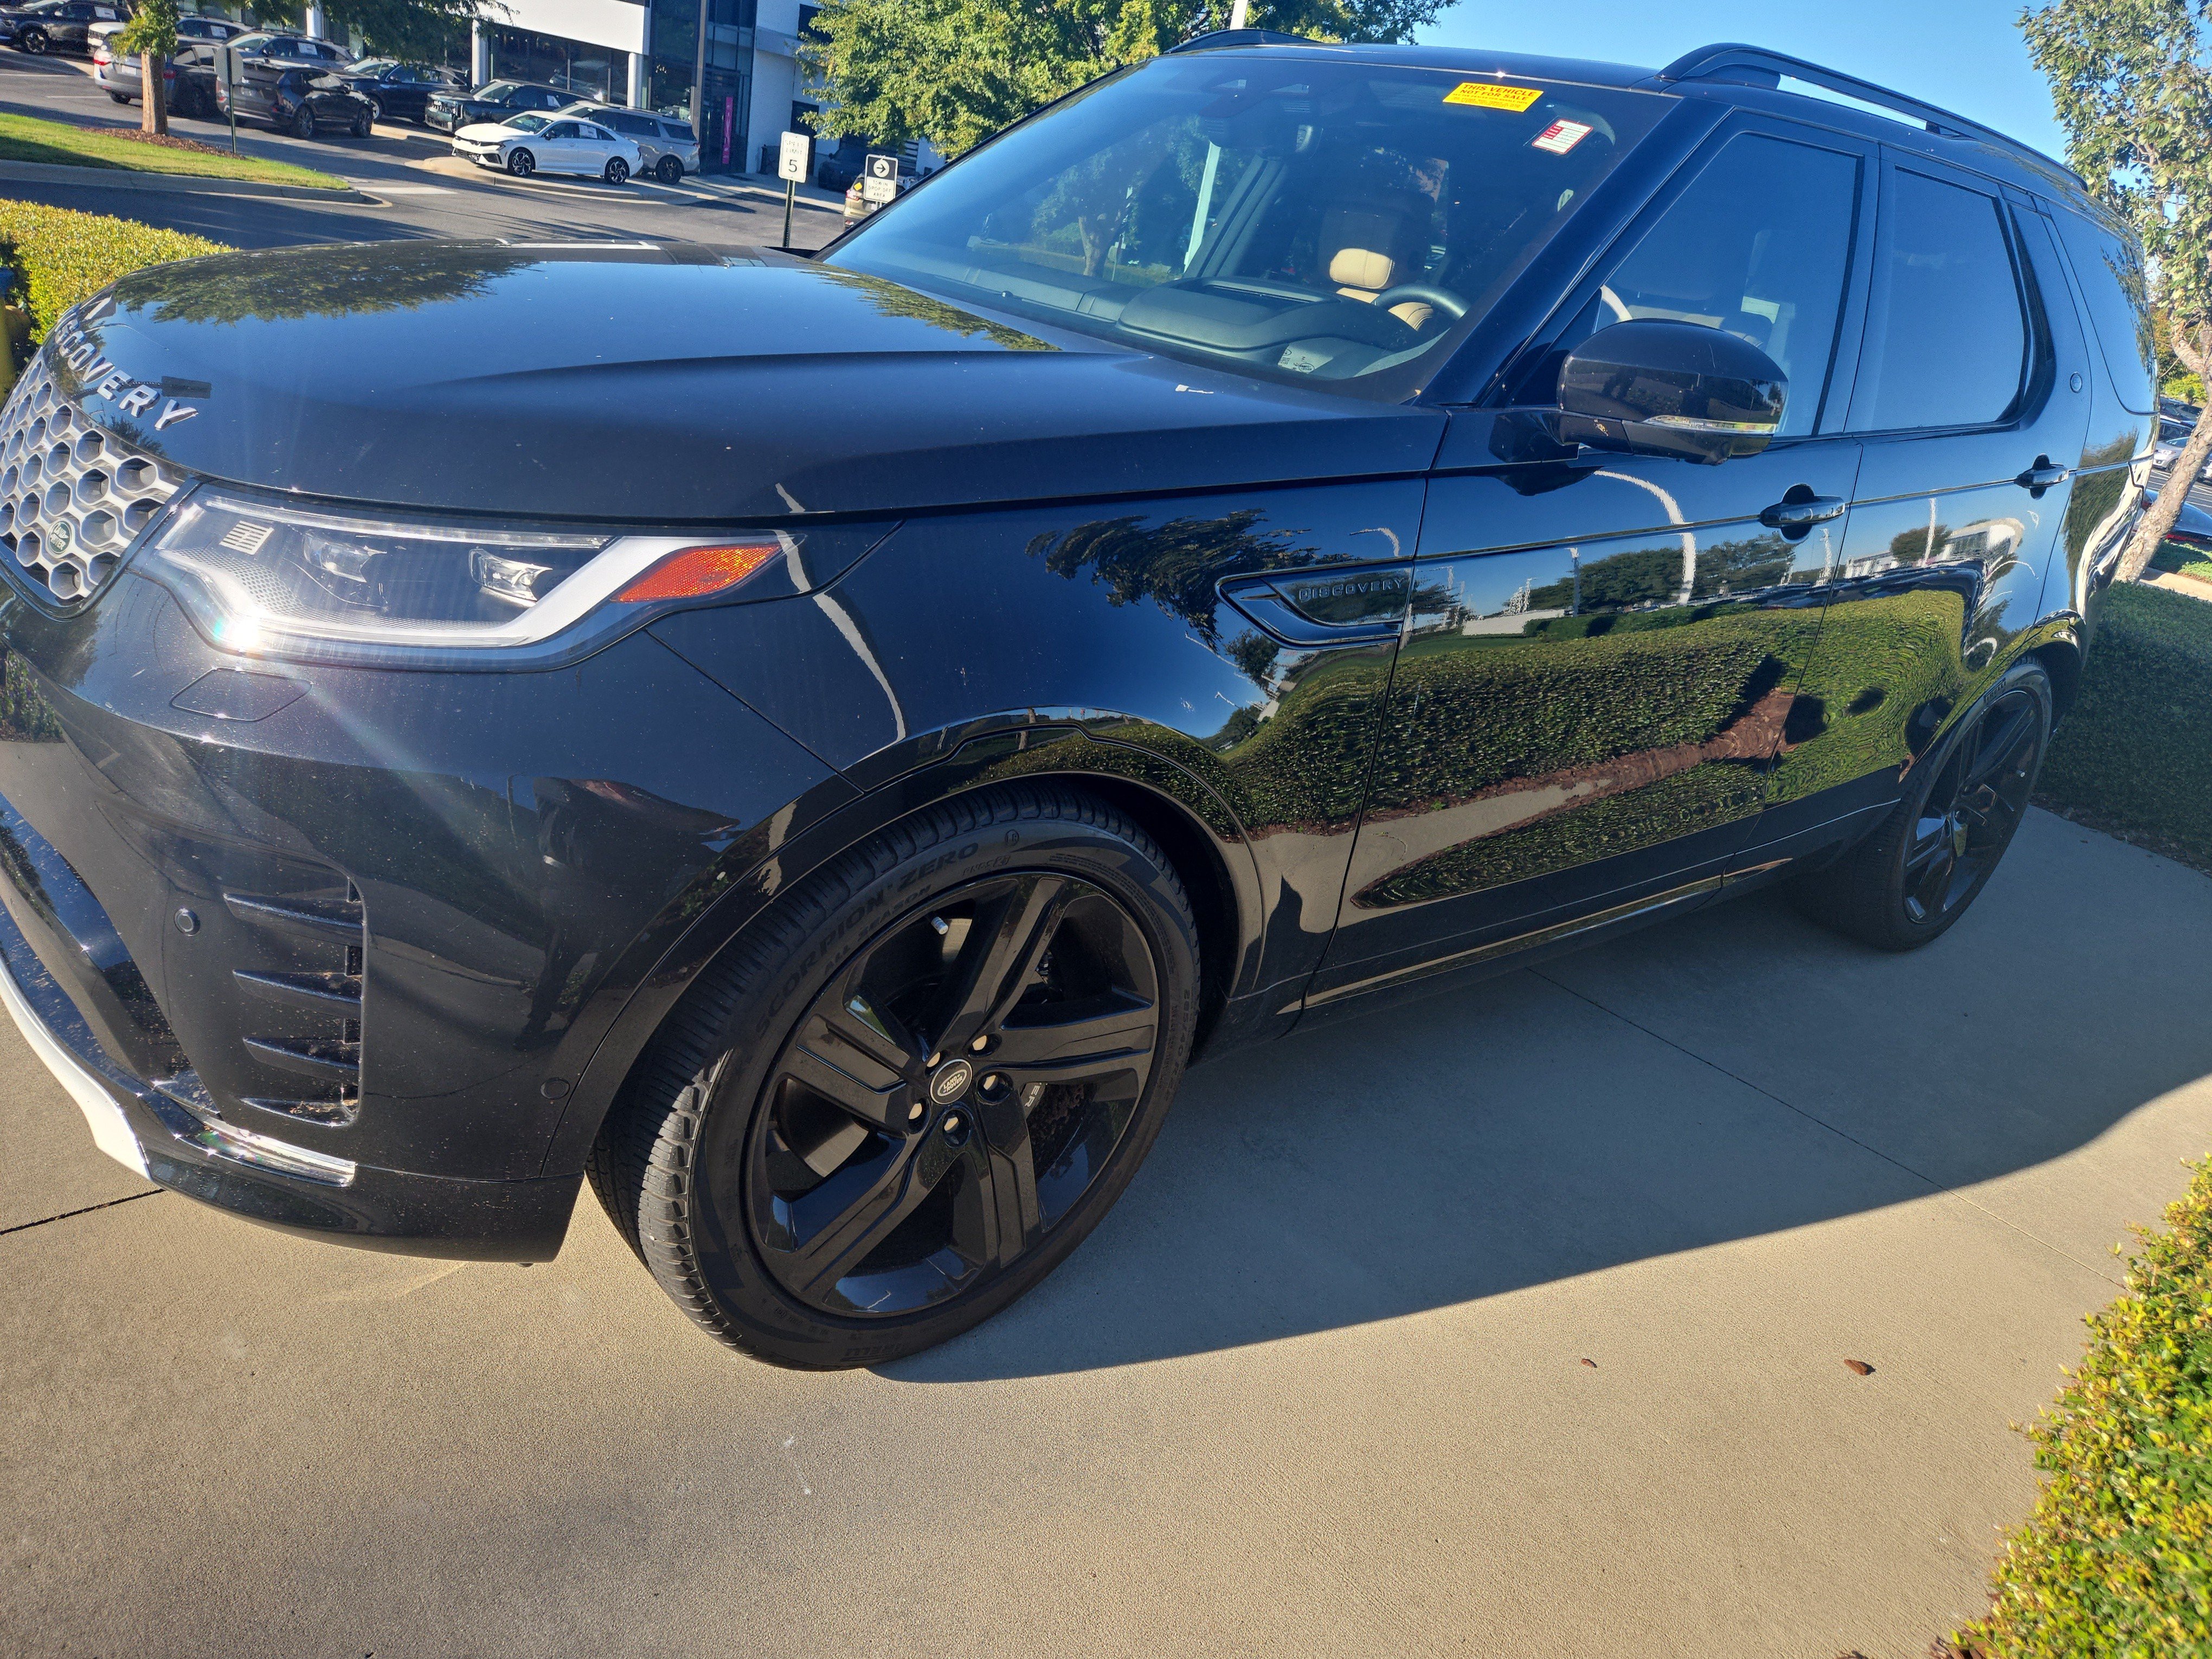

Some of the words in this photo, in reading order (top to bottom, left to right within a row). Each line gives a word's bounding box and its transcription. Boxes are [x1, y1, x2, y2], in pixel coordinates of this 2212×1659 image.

[1490, 86, 1537, 97] VEHICLE
[785, 140, 805, 149] SPEED
[788, 159, 798, 172] 5
[1298, 577, 1404, 603] DISCOVERY
[824, 945, 850, 975] ALL
[857, 884, 931, 942] SEASON
[756, 889, 885, 1040] SCORPION
[897, 843, 979, 892] ZERO
[943, 1076, 957, 1090] LAND
[946, 1076, 963, 1092] ROVER
